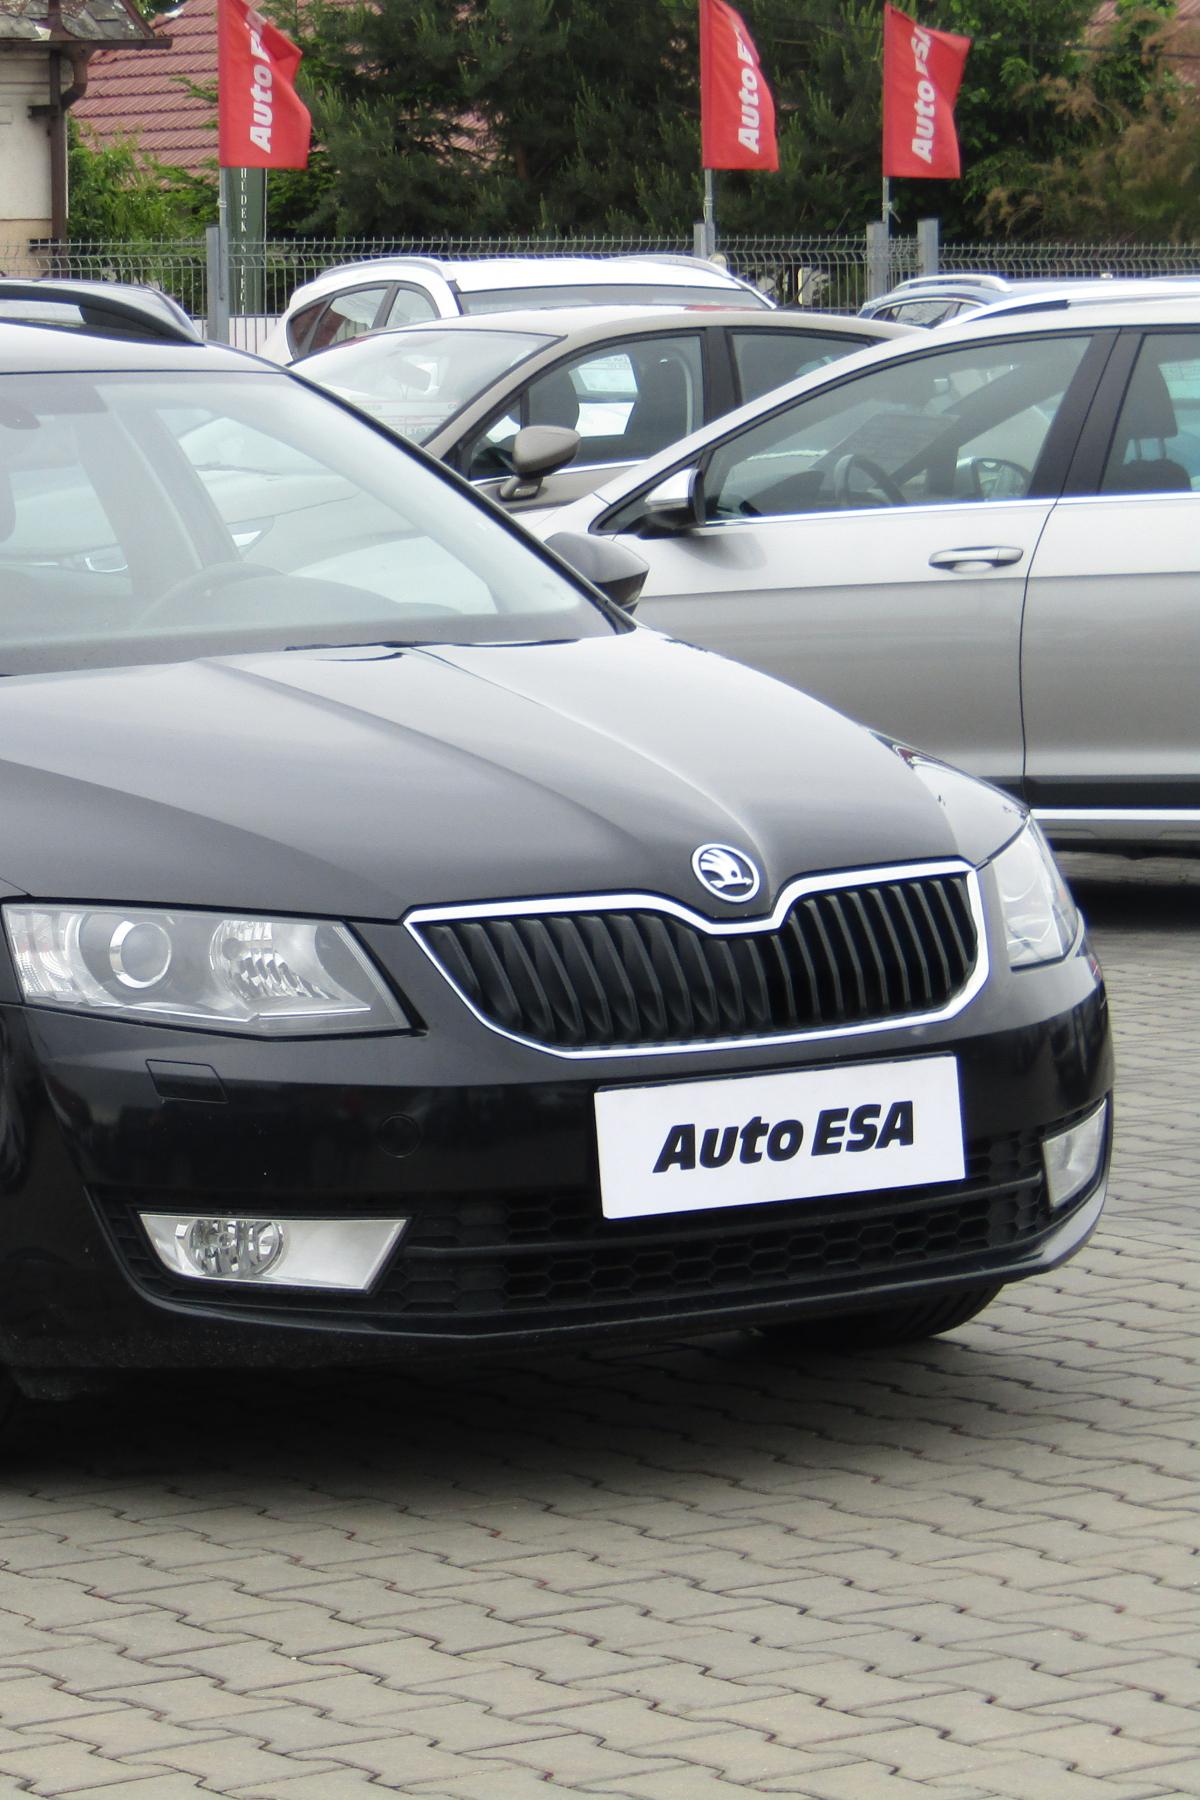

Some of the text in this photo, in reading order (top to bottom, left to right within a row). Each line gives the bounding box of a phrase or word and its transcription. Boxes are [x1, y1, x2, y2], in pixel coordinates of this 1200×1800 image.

[250, 64, 272, 153] Auto
[738, 68, 760, 155] Auto
[912, 80, 935, 164] Auto
[651, 1100, 914, 1173] Auto ESA
